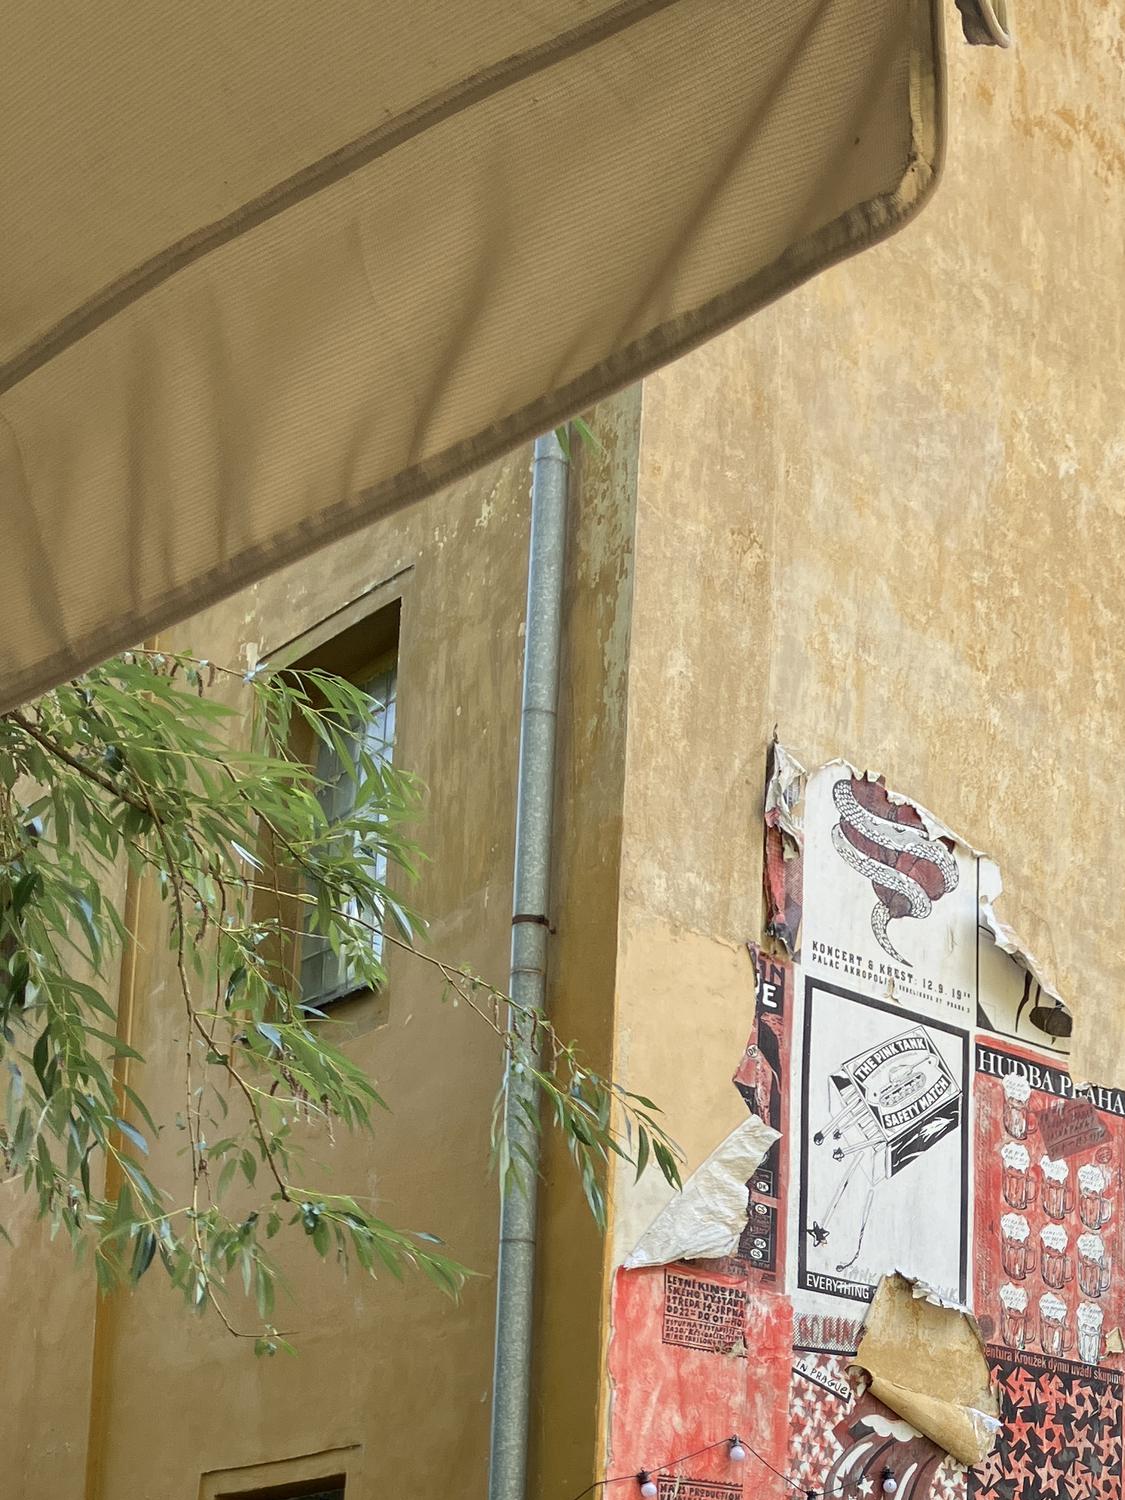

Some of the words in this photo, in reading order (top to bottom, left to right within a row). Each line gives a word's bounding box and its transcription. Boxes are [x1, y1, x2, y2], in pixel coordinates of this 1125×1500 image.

[812, 940, 863, 967] KONCERT
[868, 959, 874, 971] &
[844, 966, 889, 986] AKROPOLI
[854, 1056, 875, 1082] THE
[873, 1042, 900, 1064] PINK
[896, 1038, 926, 1052] TANK
[978, 1048, 1055, 1094] HUDBA
[884, 1105, 921, 1128] SAFETY
[919, 1078, 950, 1111] MATCH
[806, 1272, 871, 1300] EVERYTHING
[796, 1360, 808, 1372] IN
[984, 1346, 1012, 1362] entura
[1014, 1350, 1047, 1369] Kroužek
[1071, 1362, 1093, 1378] uvádí
